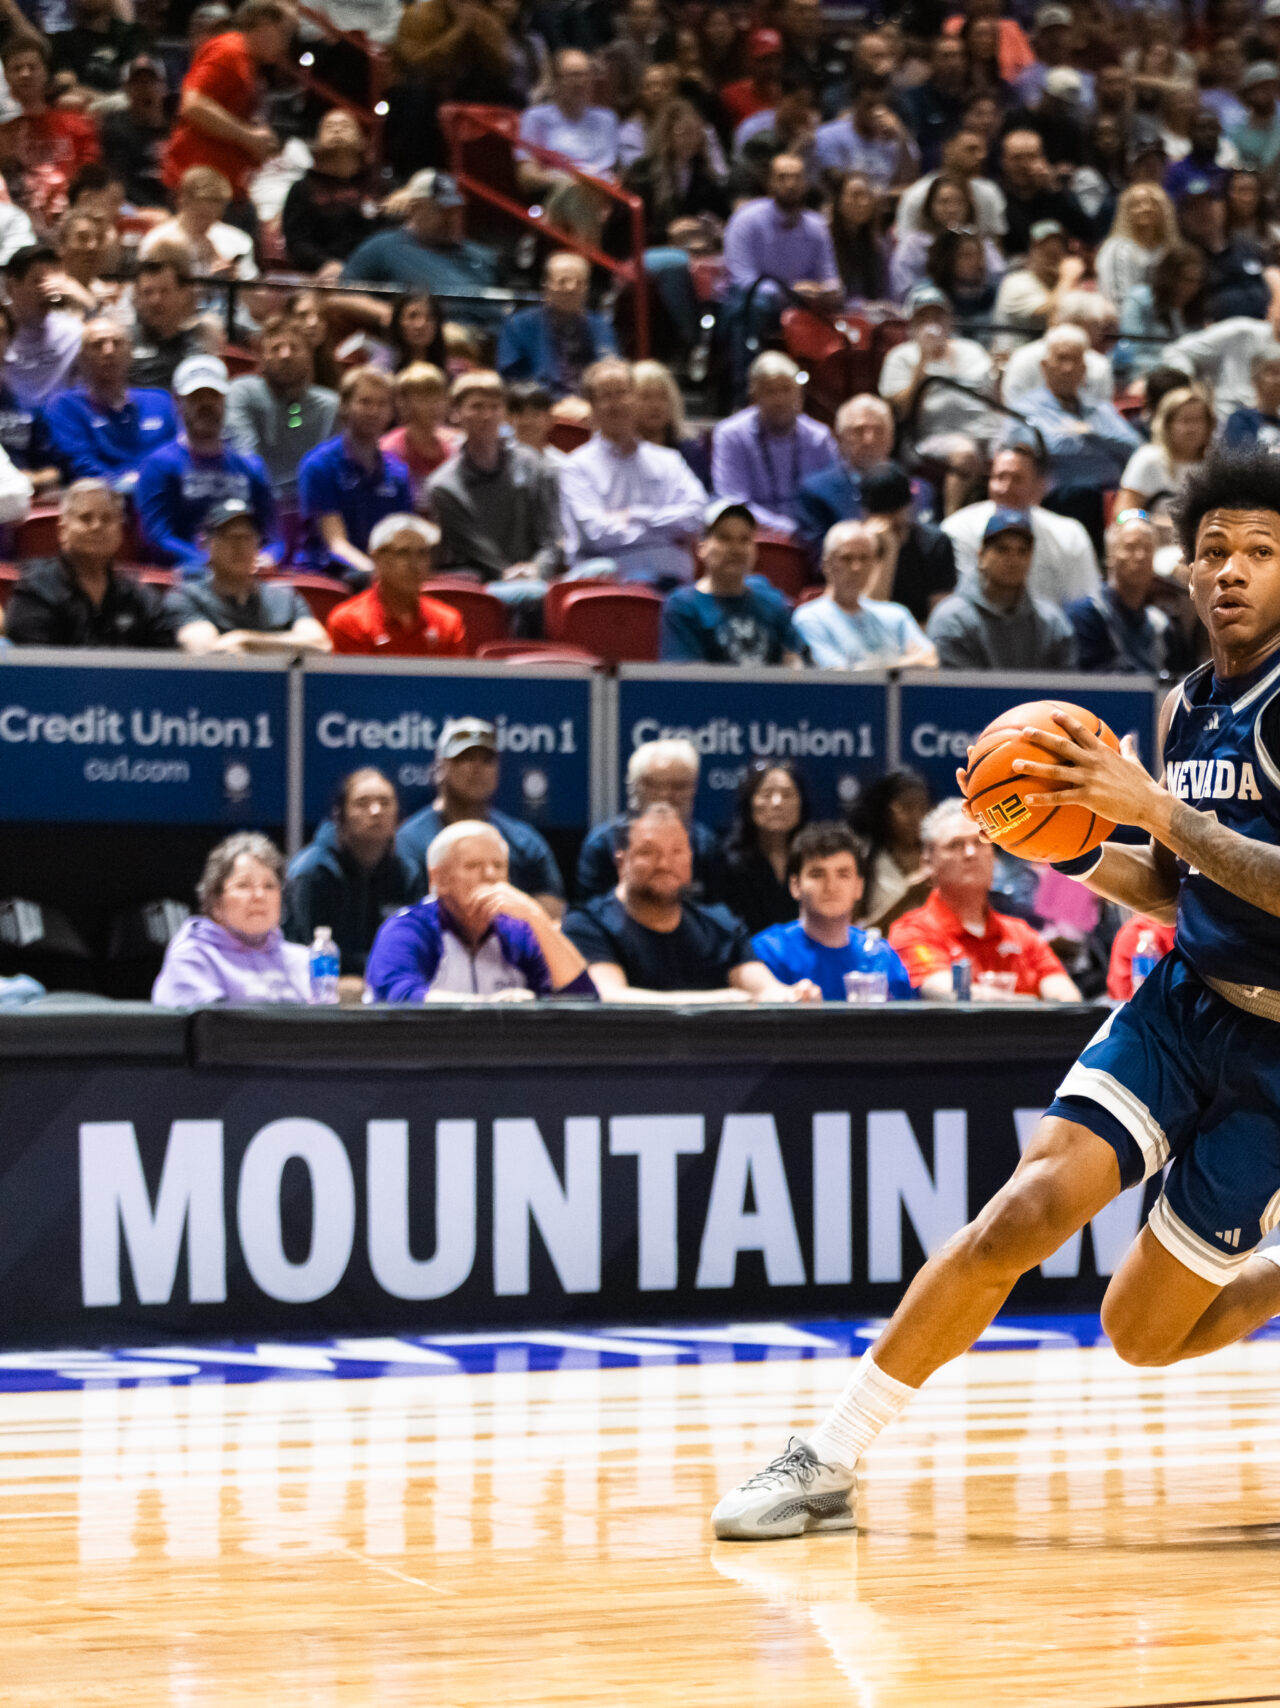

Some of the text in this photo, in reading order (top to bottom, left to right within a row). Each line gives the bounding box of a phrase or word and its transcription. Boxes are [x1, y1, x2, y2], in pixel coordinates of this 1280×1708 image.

[0, 704, 125, 744] Credit
[316, 711, 436, 750] Credit
[1166, 759, 1263, 801] NEVADA
[79, 1109, 969, 1308] MOUNTAIN
